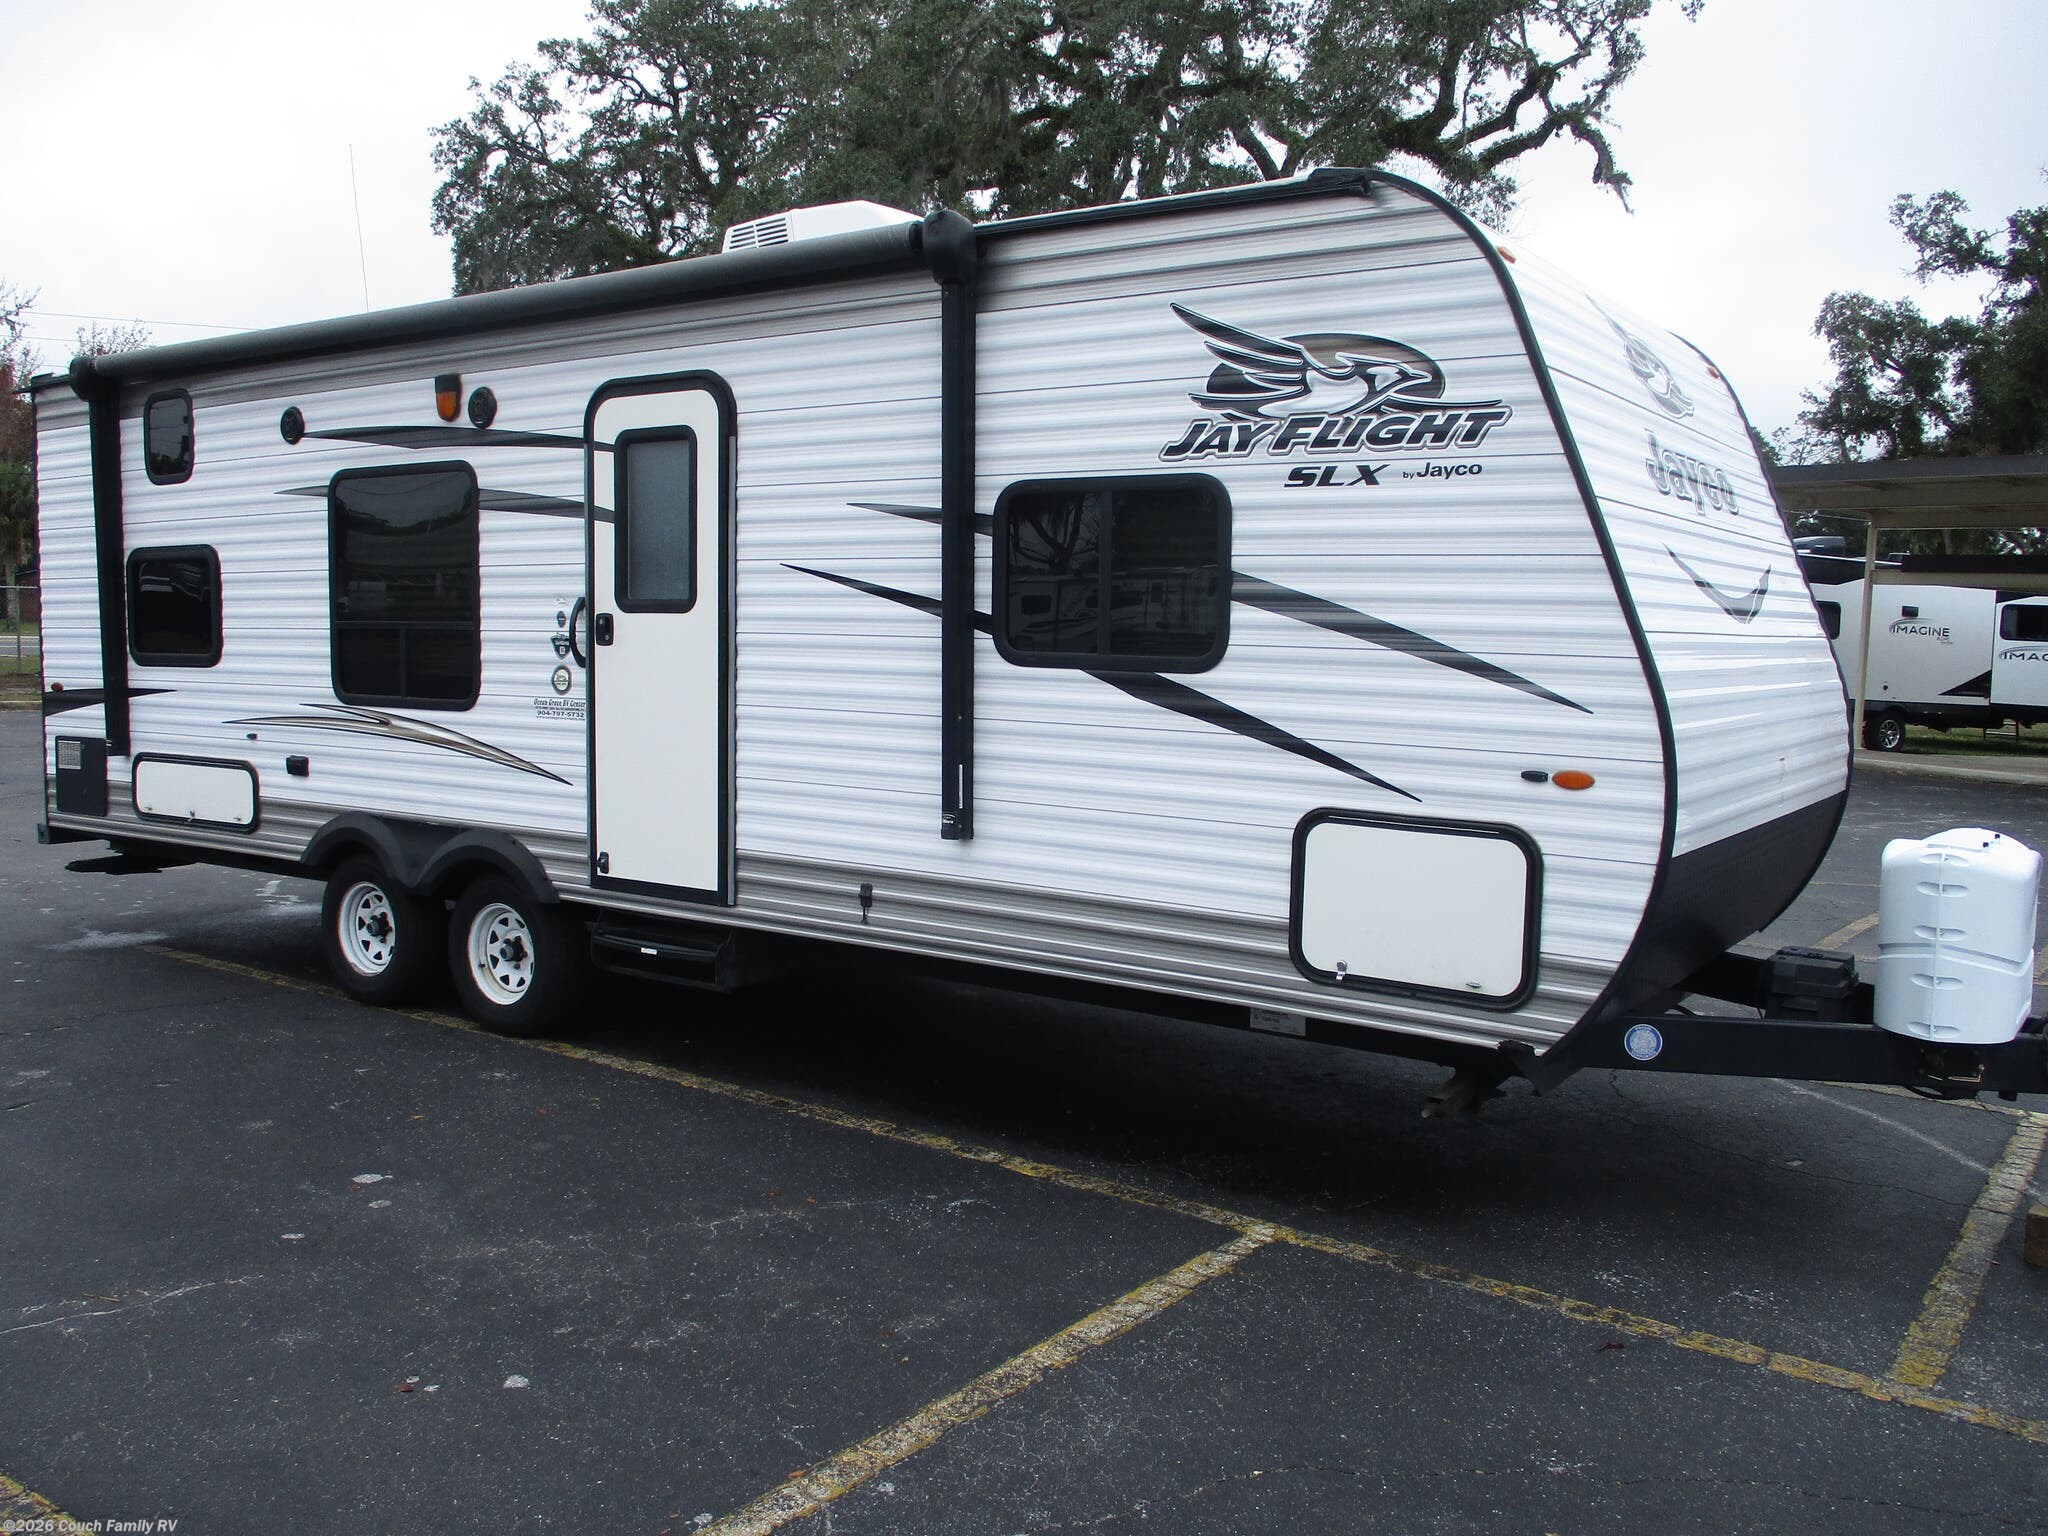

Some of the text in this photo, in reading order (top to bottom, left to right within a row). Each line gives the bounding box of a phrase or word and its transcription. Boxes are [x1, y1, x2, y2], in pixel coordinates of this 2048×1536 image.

[1284, 462, 1483, 488] SLX by Jayco
[1644, 428, 1739, 516] Jayco
[1892, 624, 1951, 637] IMAGINE
